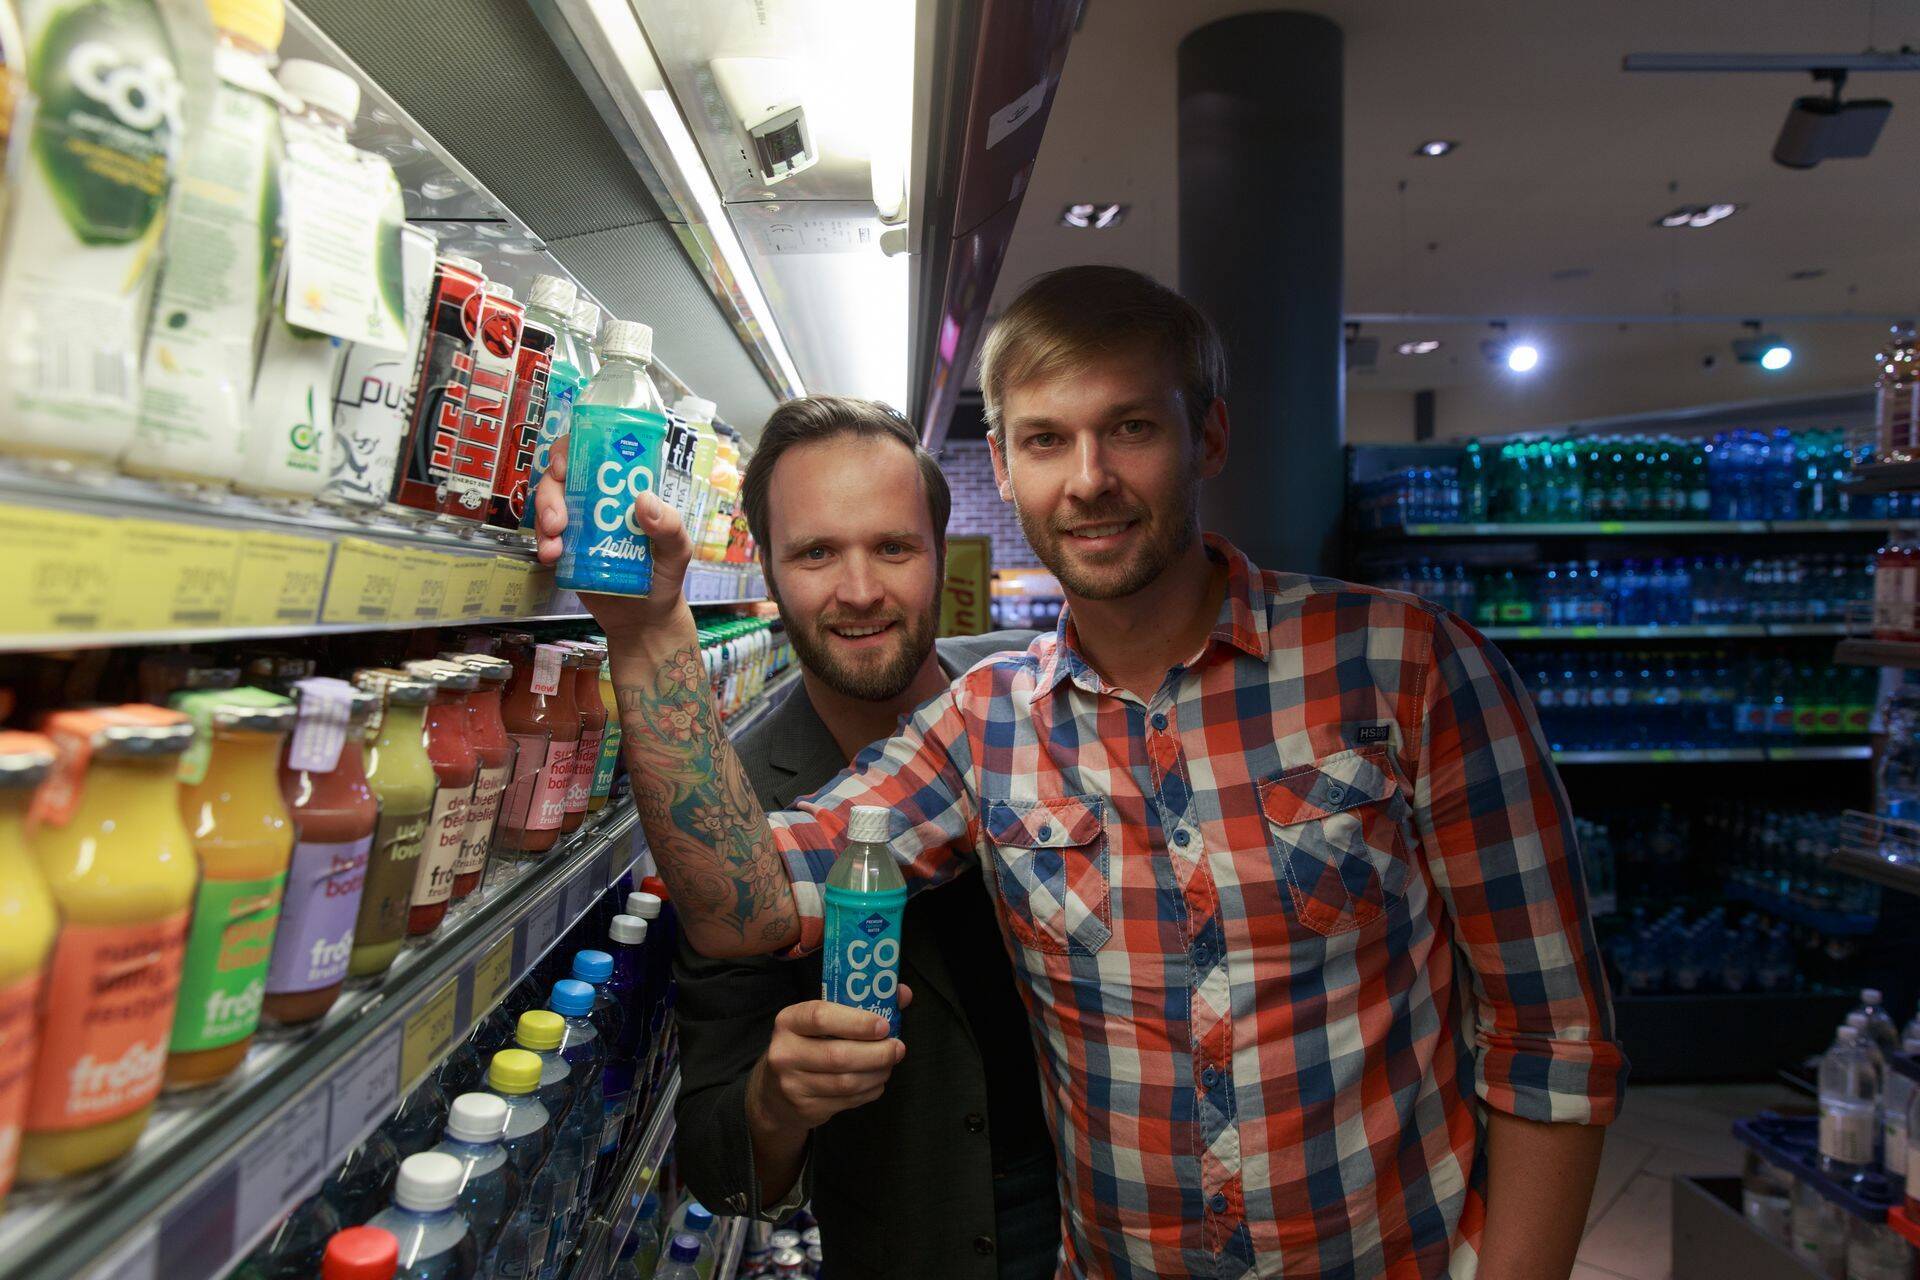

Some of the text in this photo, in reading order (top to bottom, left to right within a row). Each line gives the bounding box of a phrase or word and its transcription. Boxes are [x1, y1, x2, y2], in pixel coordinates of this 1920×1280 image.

[597, 460, 654, 499] CO
[588, 534, 646, 562] Active
[534, 683, 555, 693] new
[847, 938, 900, 970] CO
[846, 969, 898, 1002] CO
